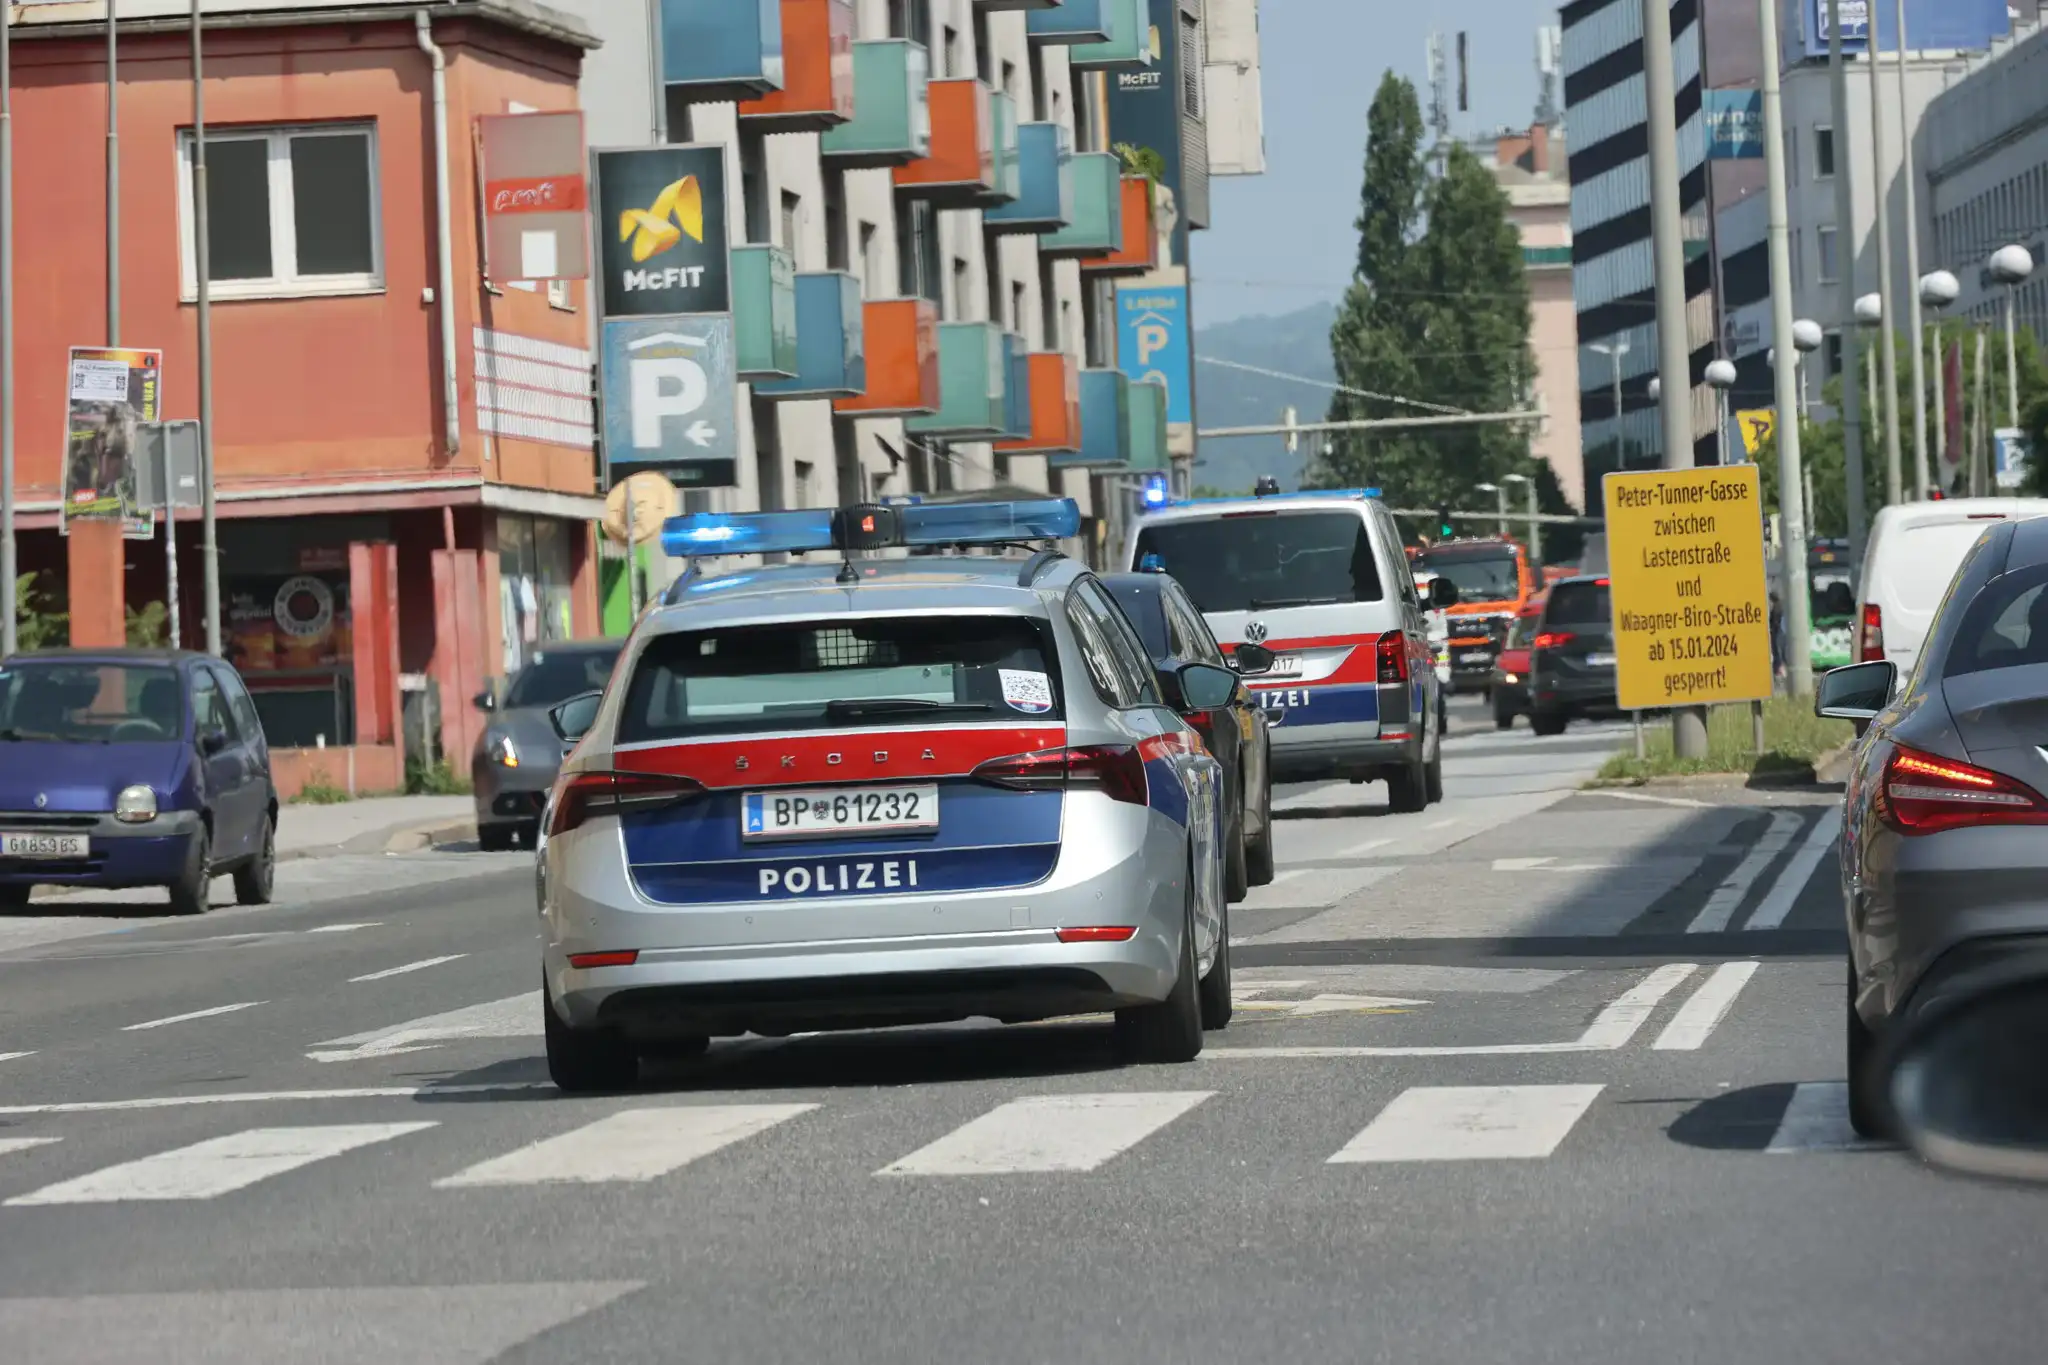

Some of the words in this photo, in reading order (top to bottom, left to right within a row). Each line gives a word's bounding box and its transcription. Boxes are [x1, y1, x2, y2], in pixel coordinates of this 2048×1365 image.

[1117, 72, 1161, 85] McFIT
[623, 265, 704, 292] McFIT
[630, 358, 707, 448] P
[1617, 480, 1748, 508] Peter-Tunner-Gasse
[1654, 512, 1716, 536] zwischen
[1642, 541, 1732, 569] Lastenstraße
[1676, 574, 1702, 597] und
[1620, 602, 1762, 635] Waagner-Biro-Straße
[1648, 639, 1665, 661] ab
[1669, 634, 1738, 661] 15.01.2024
[1664, 665, 1727, 696] gesperrt!
[1260, 689, 1310, 709] IZEI
[832, 792, 920, 824] 61232
[759, 860, 918, 894] POLIZEI
